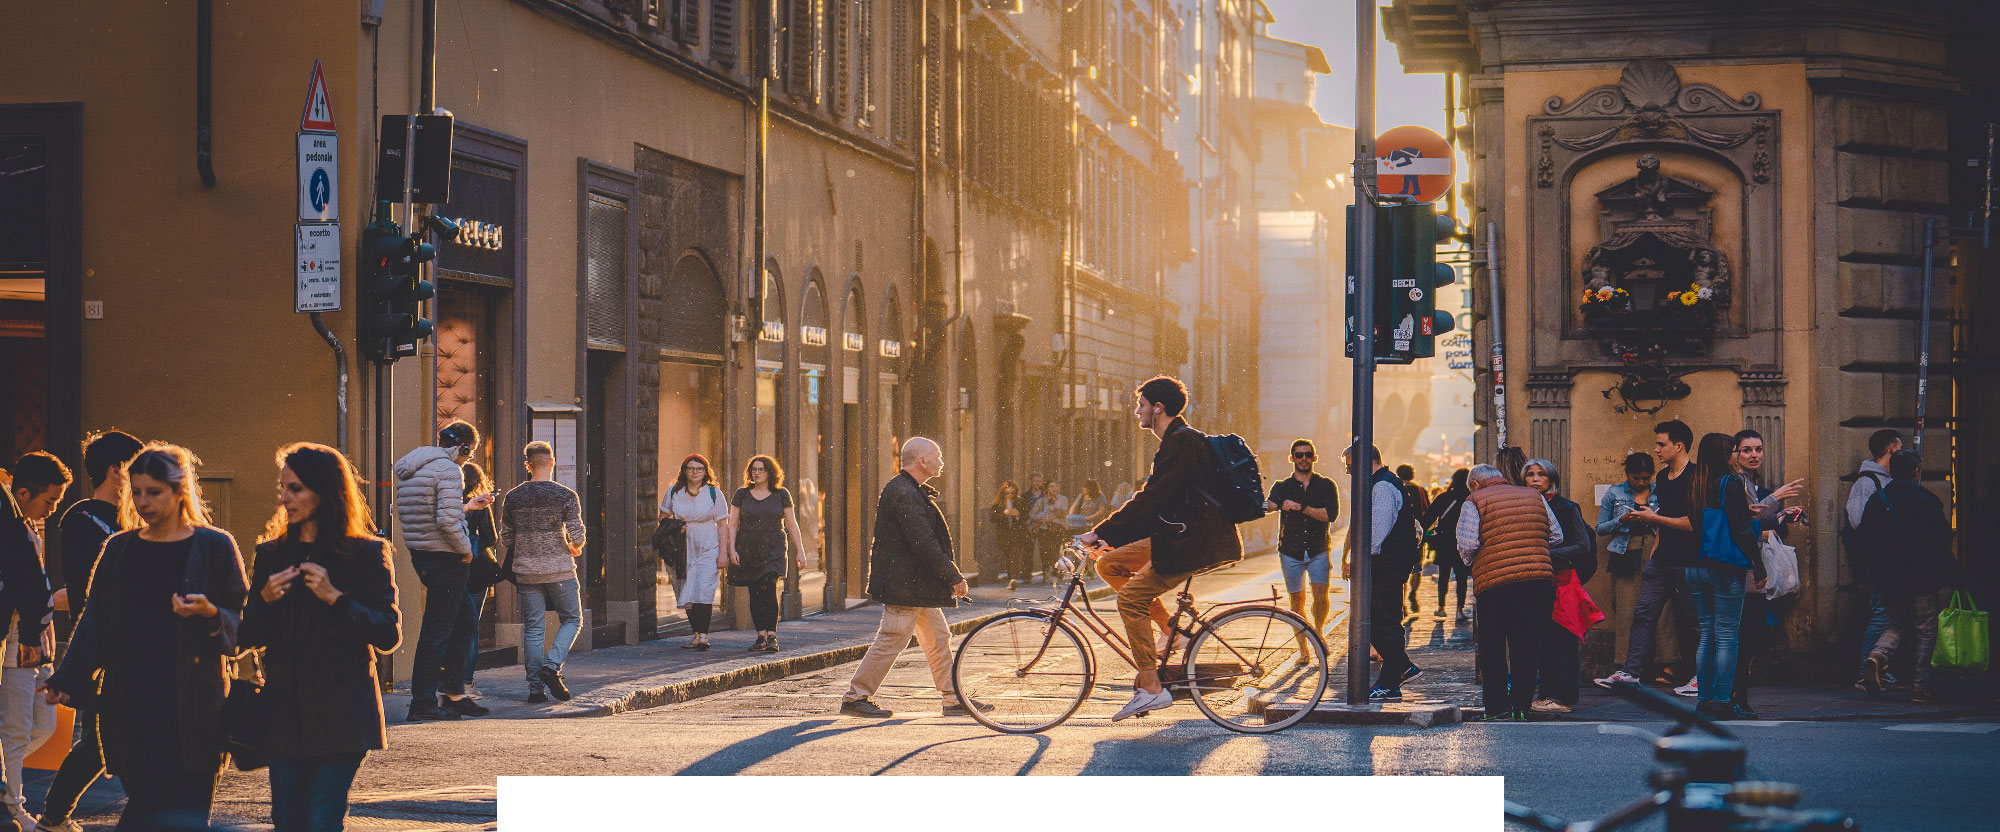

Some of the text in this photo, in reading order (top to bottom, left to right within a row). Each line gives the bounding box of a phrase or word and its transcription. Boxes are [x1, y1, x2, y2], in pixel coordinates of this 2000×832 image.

[313, 139, 327, 148] area
[306, 149, 333, 163] pedonale
[309, 229, 331, 237] eccetto
[88, 304, 100, 316] 81
